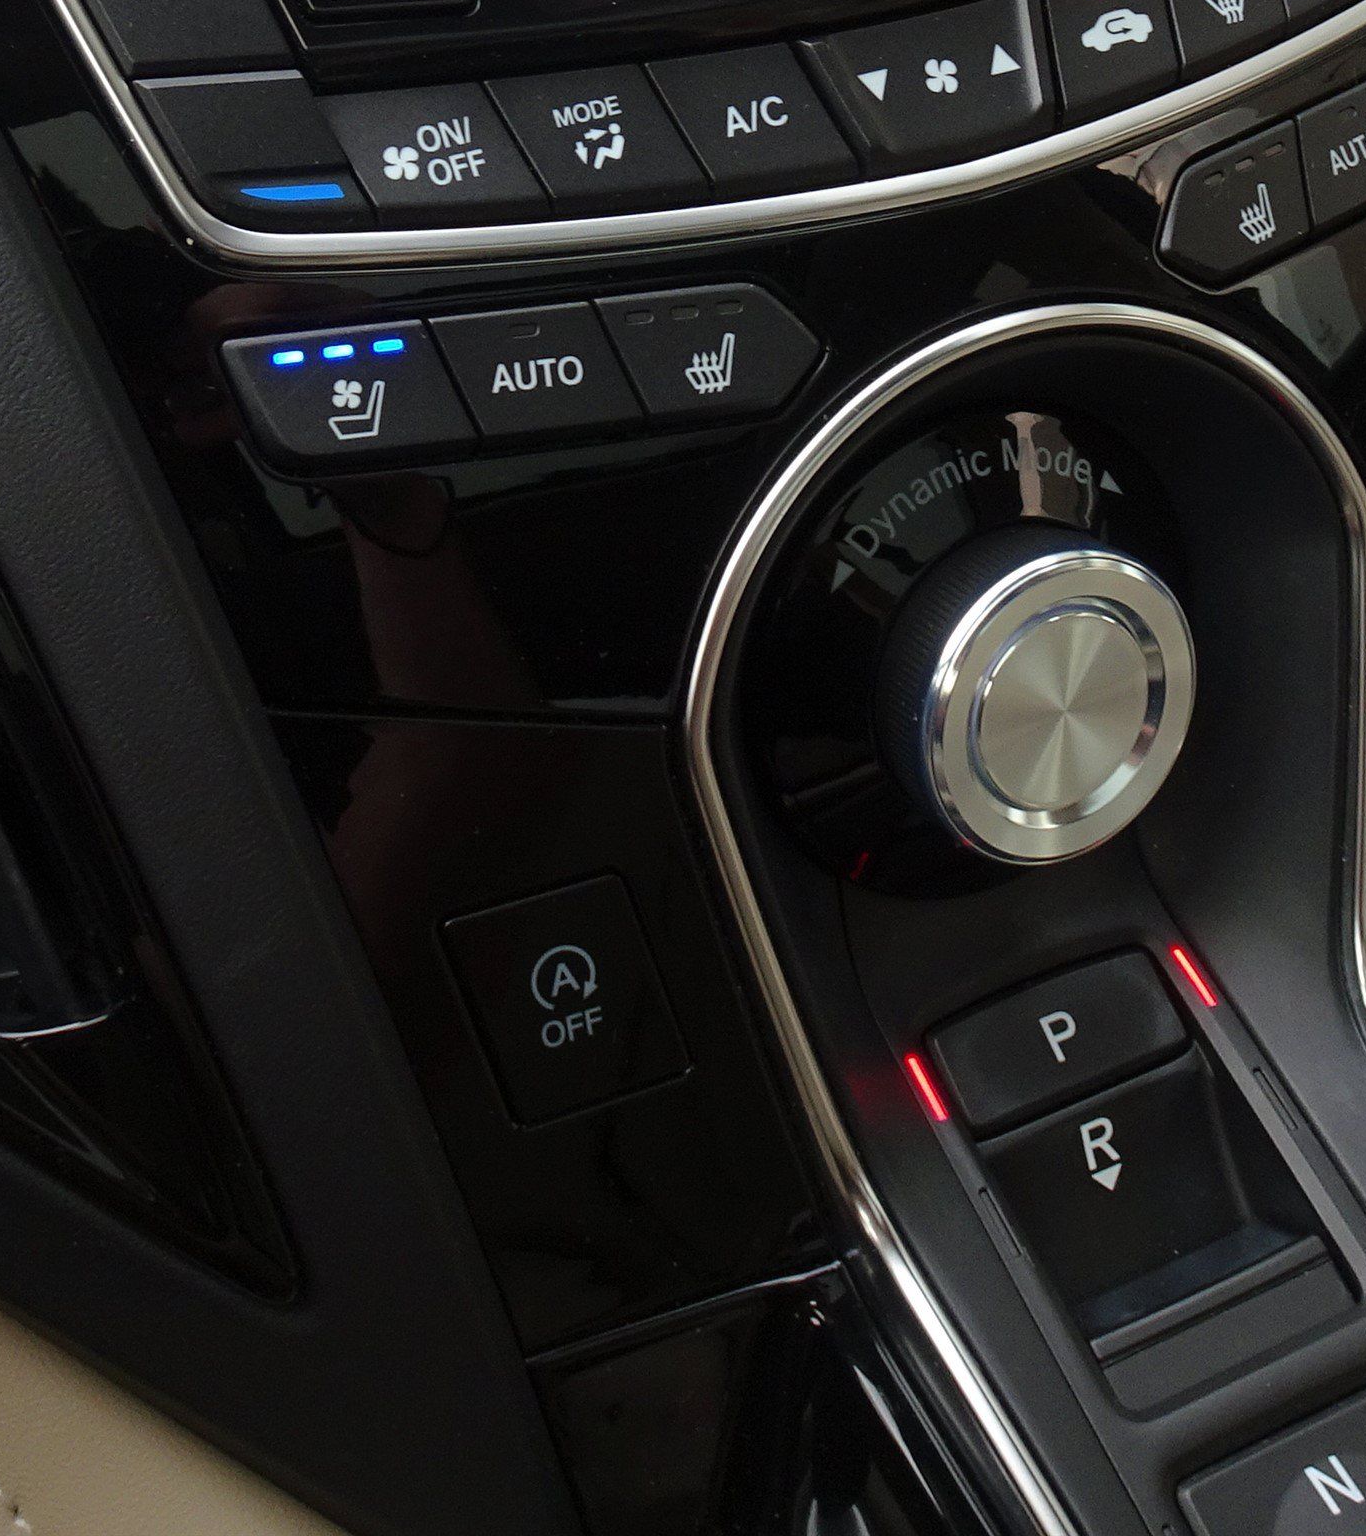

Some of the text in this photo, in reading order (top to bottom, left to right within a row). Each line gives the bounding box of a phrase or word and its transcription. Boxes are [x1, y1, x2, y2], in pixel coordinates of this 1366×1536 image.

[551, 95, 623, 128] MODE
[725, 94, 789, 139] A/C
[416, 116, 472, 154] ON/
[426, 147, 487, 187] OFF
[491, 355, 585, 395] AUTO
[844, 437, 1093, 559] Dynamic Mode
[550, 962, 581, 998] A
[541, 1005, 603, 1049] OFF
[1039, 1009, 1076, 1063] P
[1079, 1115, 1122, 1172] R
[1303, 1453, 1366, 1516] N
